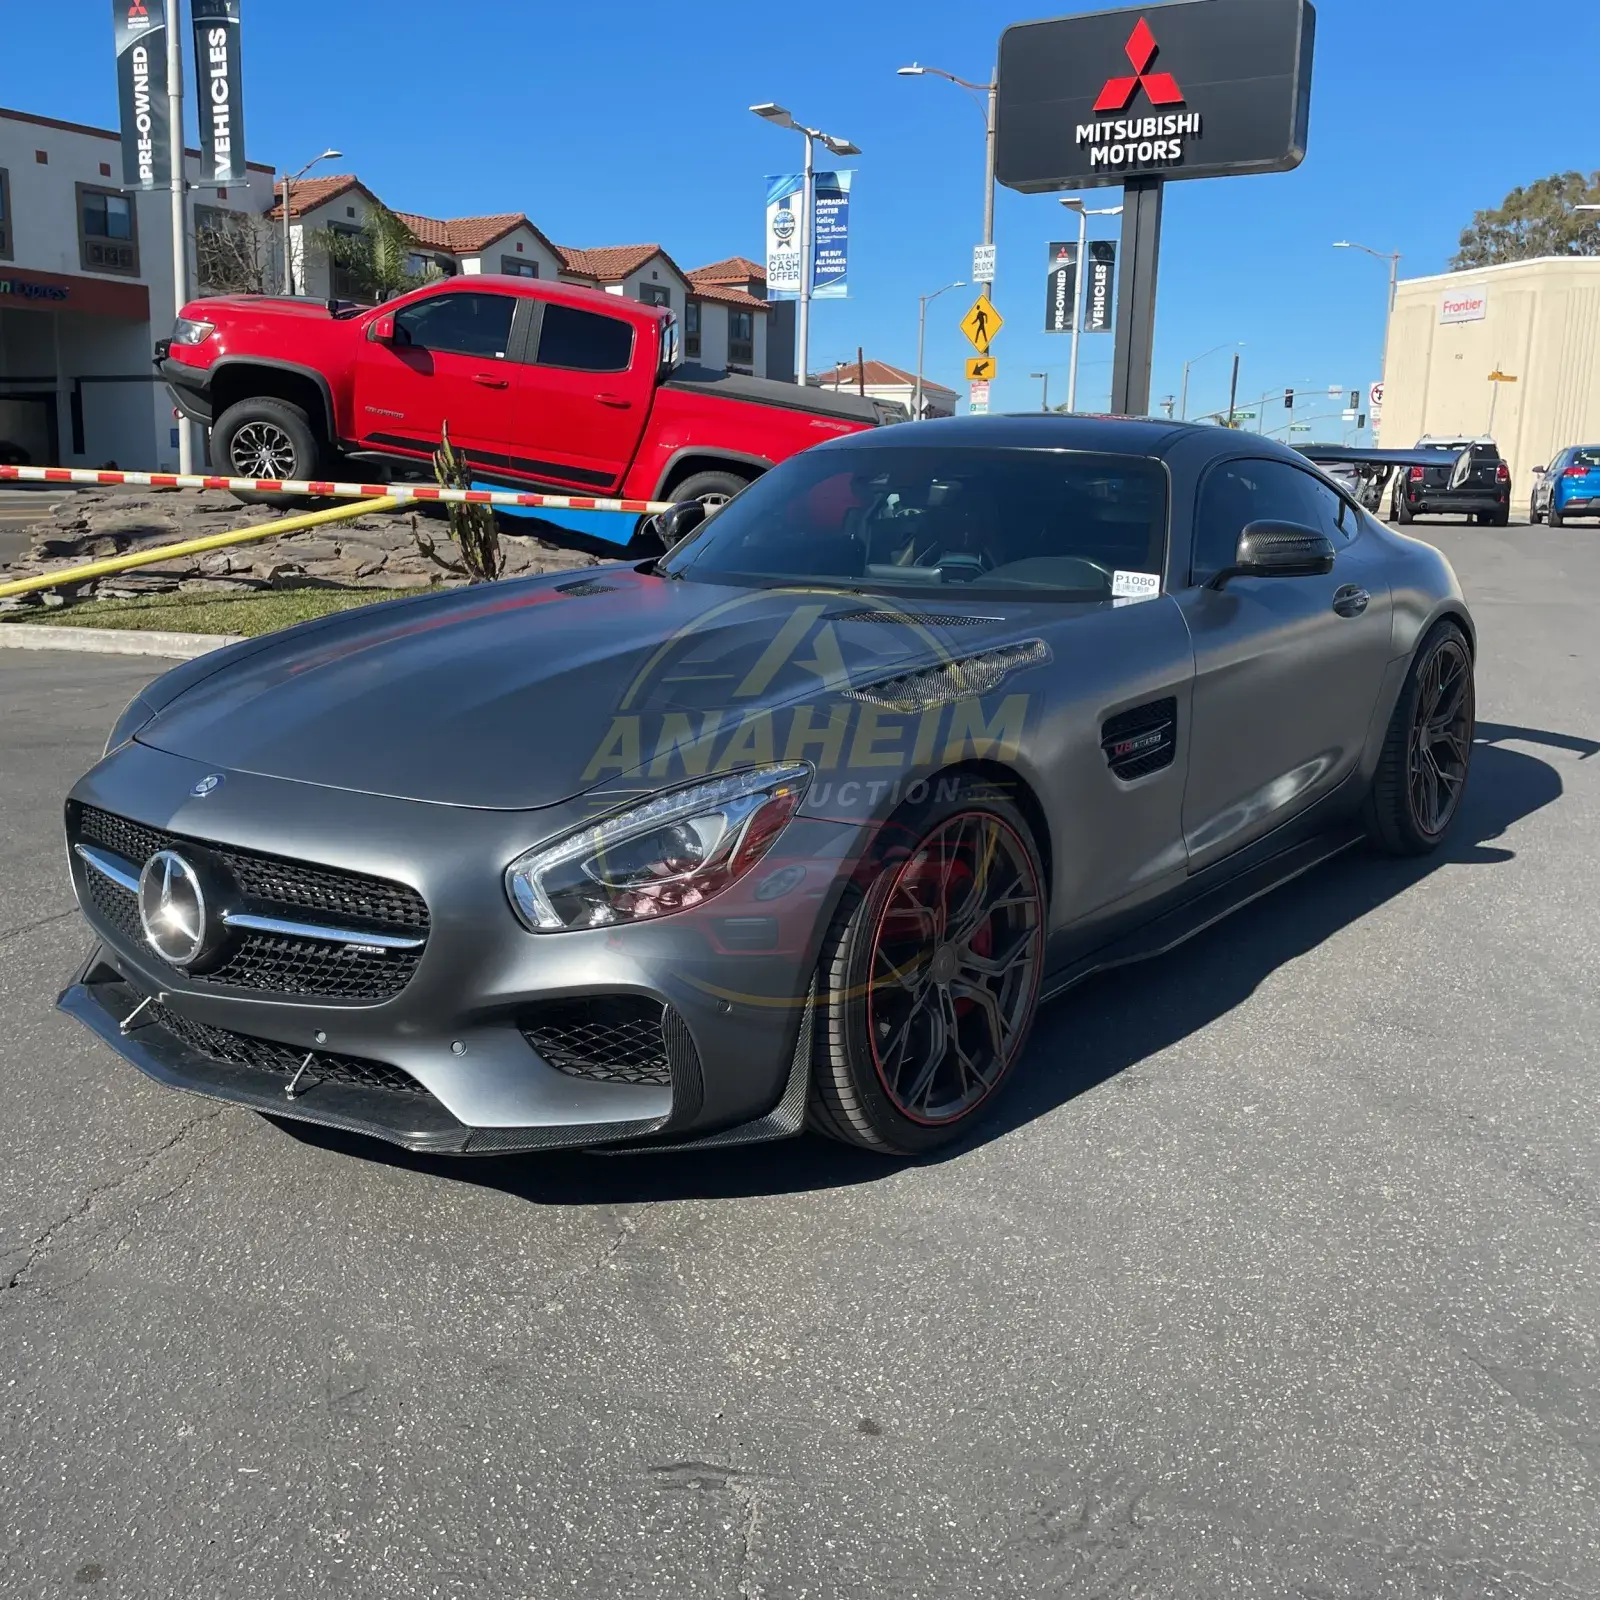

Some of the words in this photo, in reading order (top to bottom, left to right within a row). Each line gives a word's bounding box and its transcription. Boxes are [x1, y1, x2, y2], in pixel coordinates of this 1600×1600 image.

[208, 28, 231, 175] VEHICLES
[133, 46, 153, 179] PRE-OWNED
[1075, 113, 1200, 144] MITSUBISHI
[1090, 138, 1182, 166] MOTORS
[816, 216, 835, 224] Kelley
[769, 253, 799, 261] INSTANT
[975, 251, 983, 259] DO
[984, 249, 994, 258] NOT
[769, 260, 799, 271] CASH
[974, 261, 994, 271] BLOCK
[769, 271, 799, 281] OFFER
[1055, 270, 1067, 330] PRE-OWNED
[1092, 264, 1107, 329] VEHICLES
[1443, 299, 1483, 313] Frontier
[1115, 574, 1156, 587] P1080
